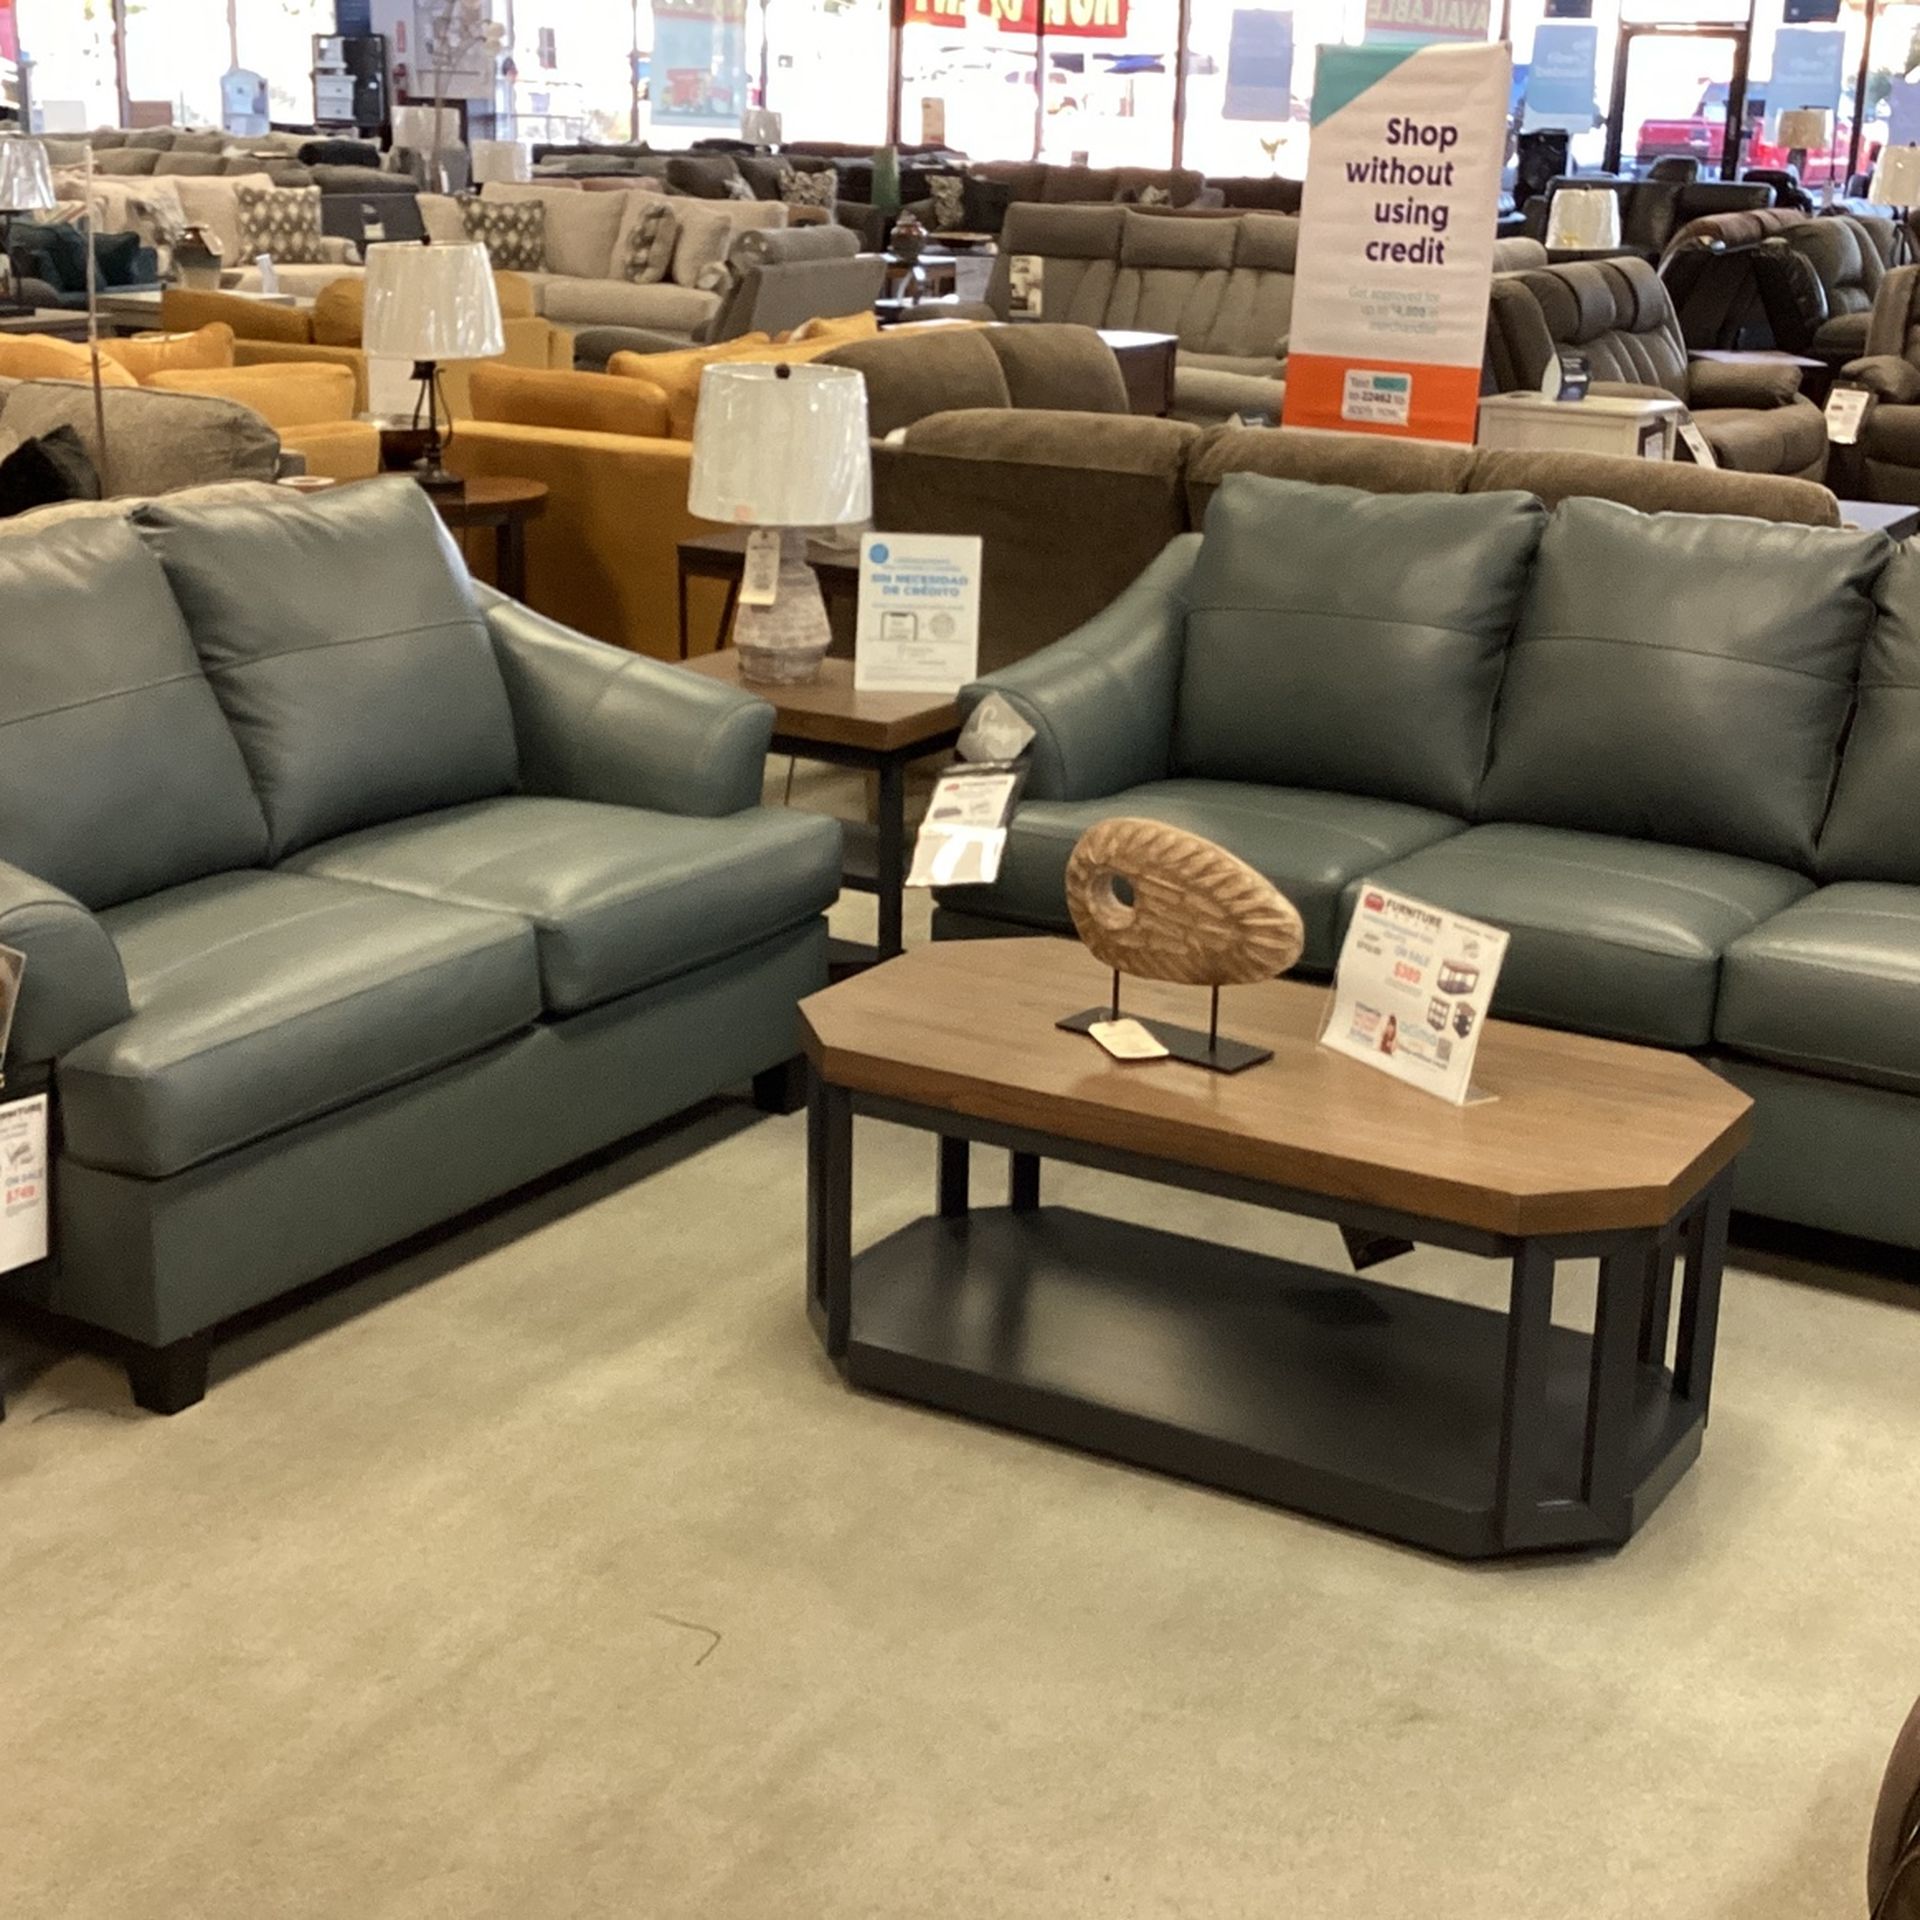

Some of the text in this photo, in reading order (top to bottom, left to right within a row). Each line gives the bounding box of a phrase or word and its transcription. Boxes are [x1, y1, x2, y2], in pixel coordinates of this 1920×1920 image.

[1386, 117, 1458, 152] Shop
[1345, 156, 1454, 186] without
[1374, 197, 1448, 232] using
[1365, 236, 1445, 264] credit
[1387, 898, 1442, 928] FURNITURE
